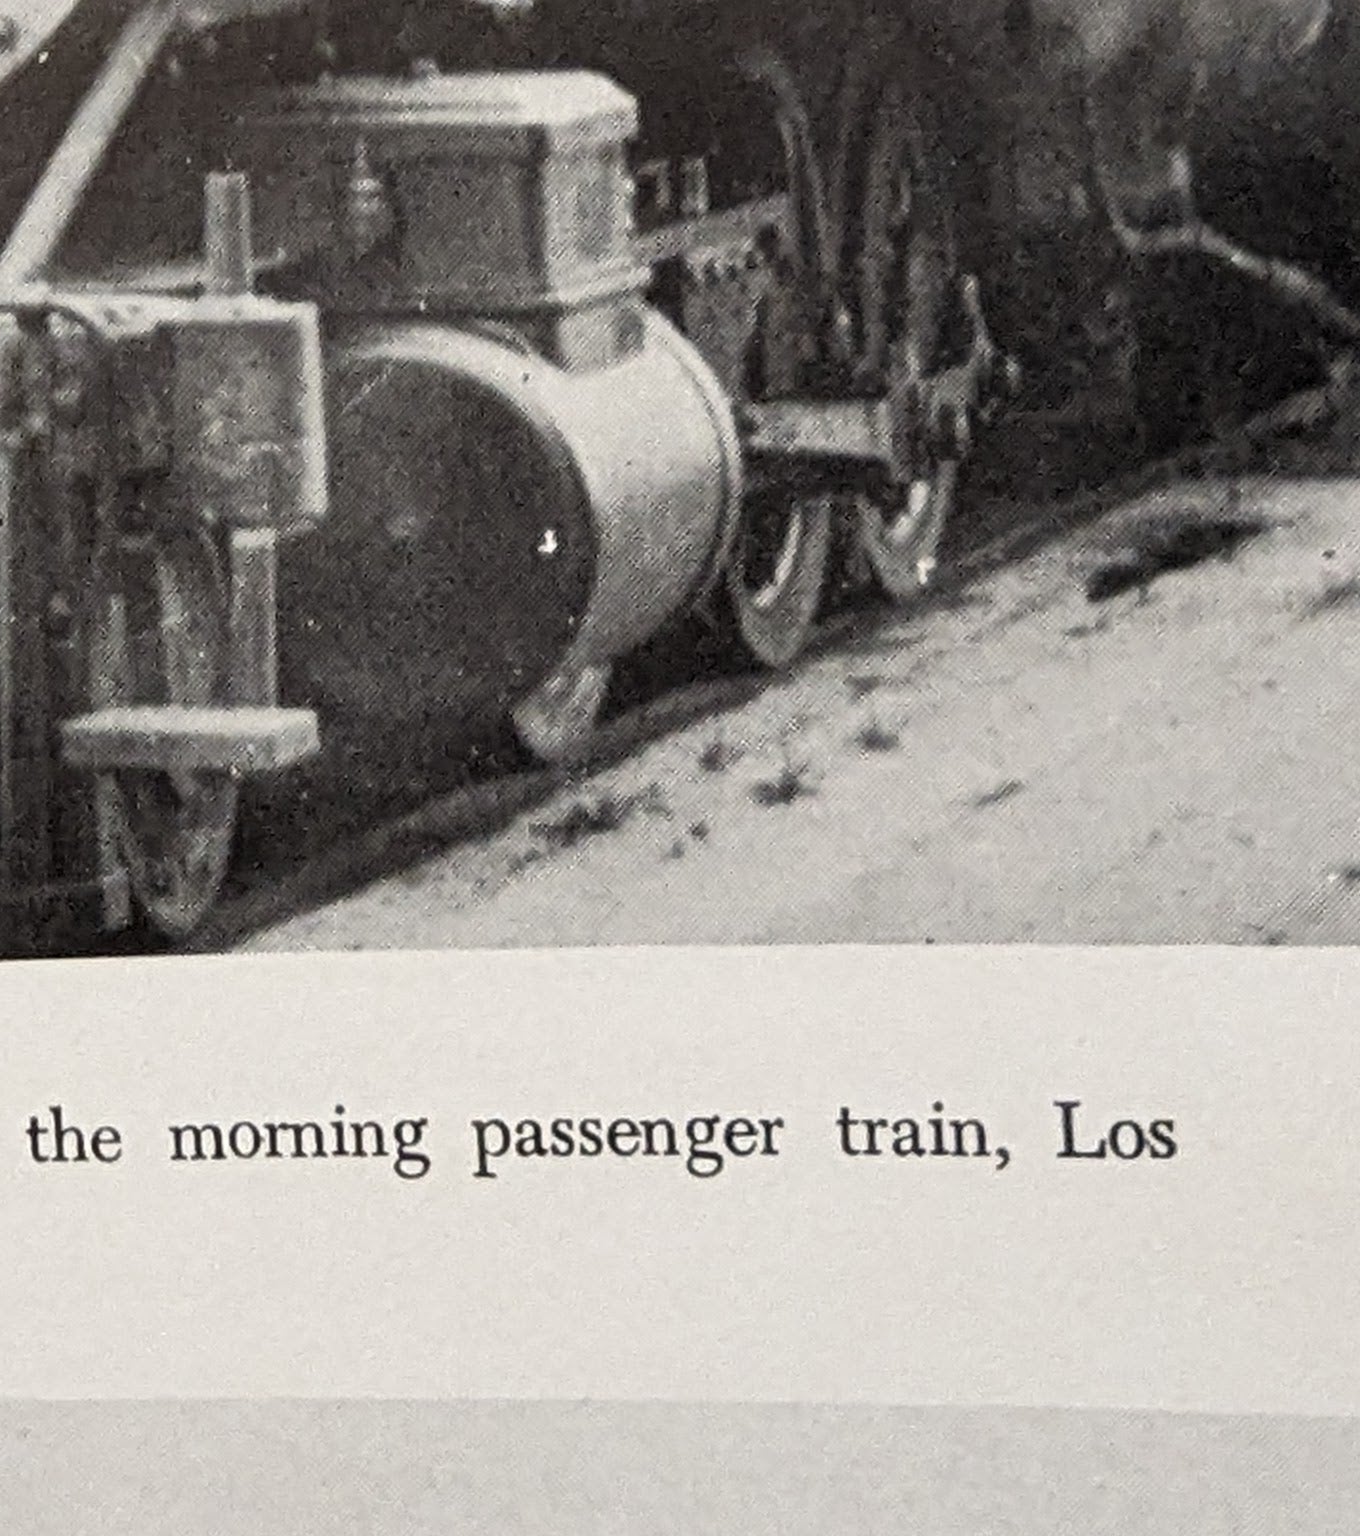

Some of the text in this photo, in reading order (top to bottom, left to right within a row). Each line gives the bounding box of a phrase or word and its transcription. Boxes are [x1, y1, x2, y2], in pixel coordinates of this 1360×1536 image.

[25, 1105, 122, 1164] the
[168, 1104, 432, 1180] morning
[471, 1118, 785, 1180] passenger
[835, 1100, 1011, 1171] train,
[1053, 1100, 1178, 1161] Los
